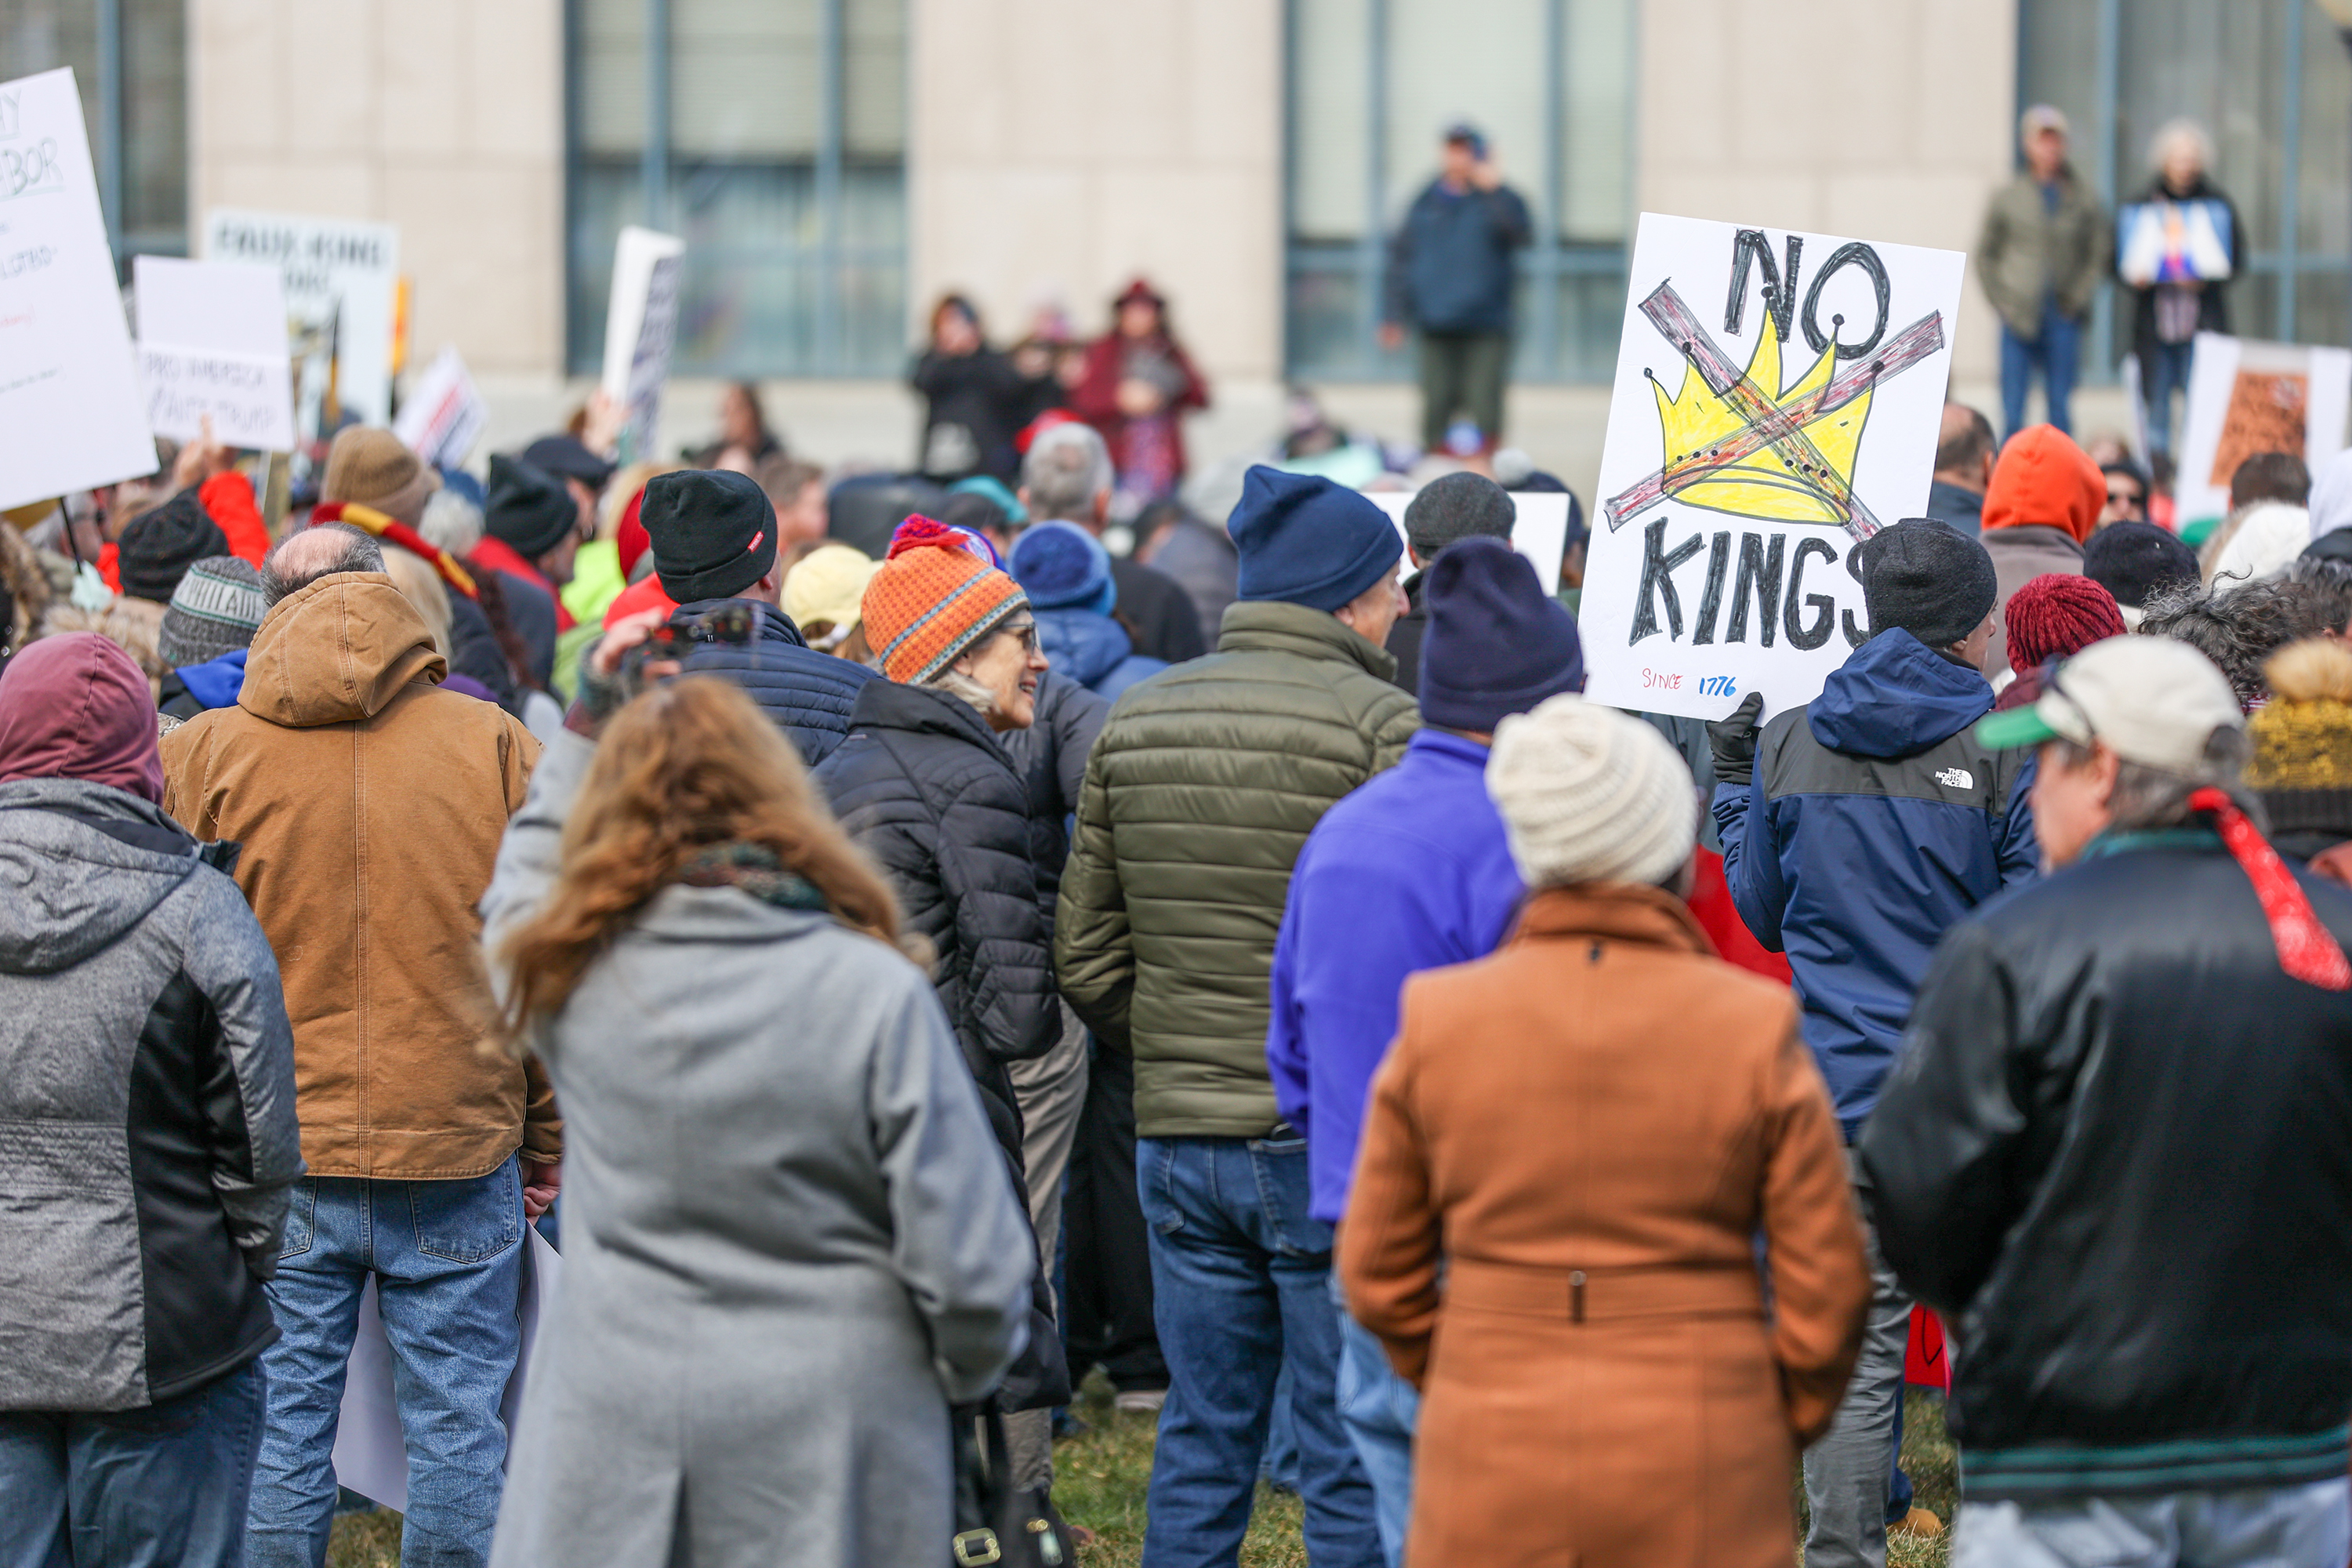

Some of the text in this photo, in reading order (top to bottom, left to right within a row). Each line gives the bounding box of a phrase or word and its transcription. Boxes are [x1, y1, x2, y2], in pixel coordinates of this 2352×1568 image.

[1724, 227, 1891, 360] NO
[1642, 667, 1737, 697] SINCE 1776
[1935, 771, 1961, 782] NORTH
[1941, 778, 1960, 787] FACE
